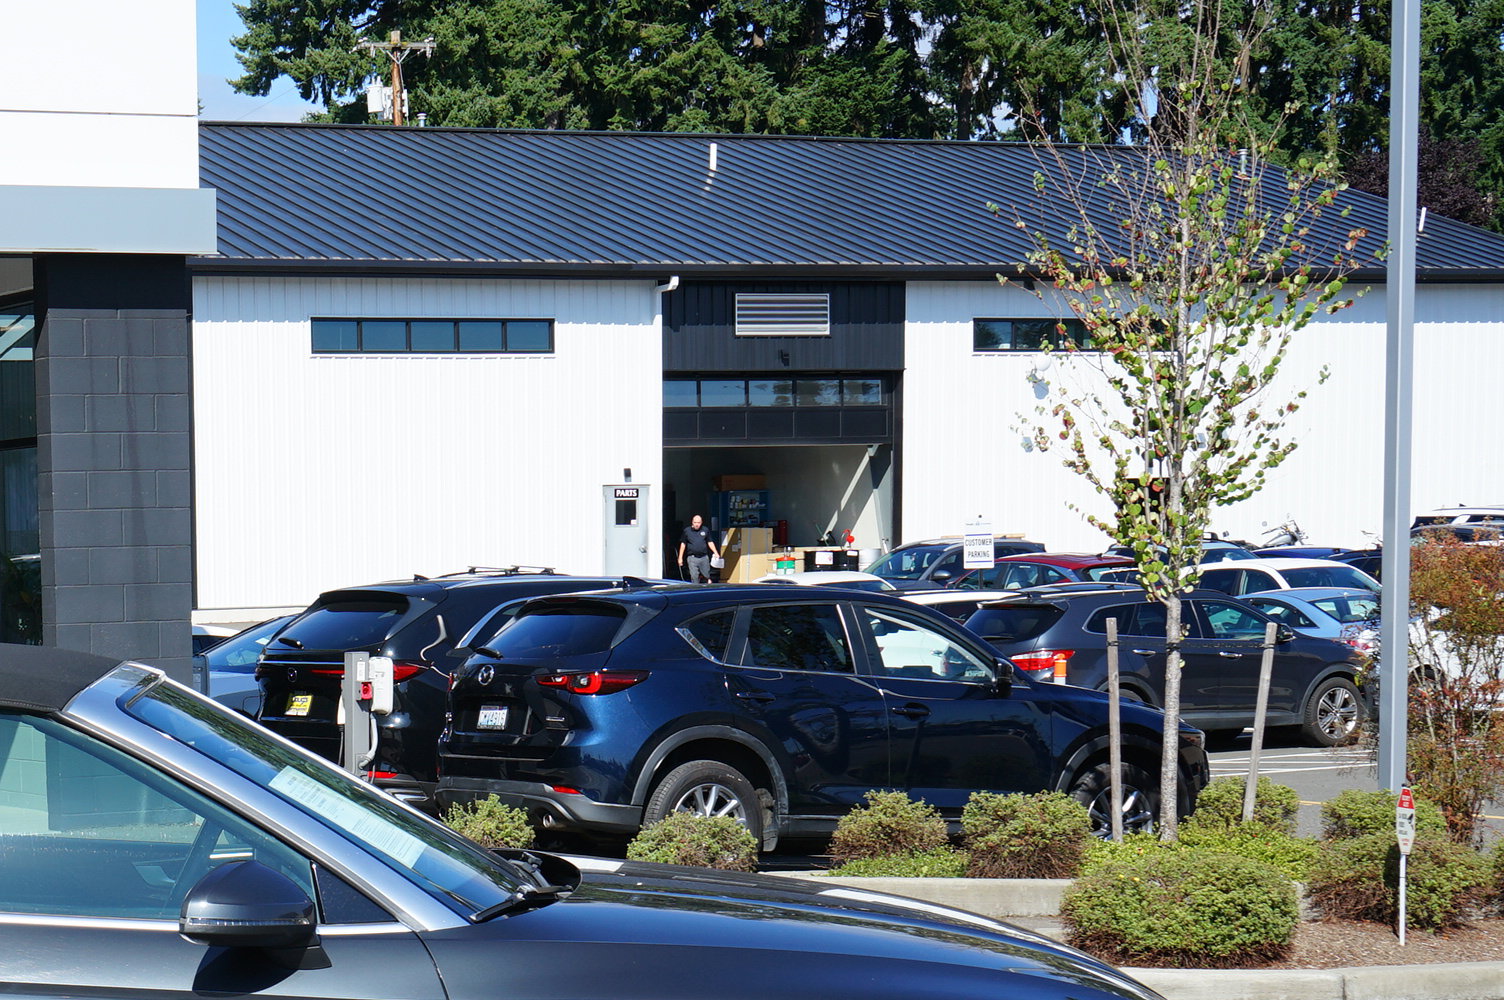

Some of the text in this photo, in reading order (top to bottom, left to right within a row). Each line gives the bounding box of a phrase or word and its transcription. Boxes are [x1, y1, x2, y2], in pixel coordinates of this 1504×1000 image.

[616, 489, 638, 497] PARTS
[965, 538, 992, 547] CUSTOMER
[968, 550, 990, 558] PARKING
